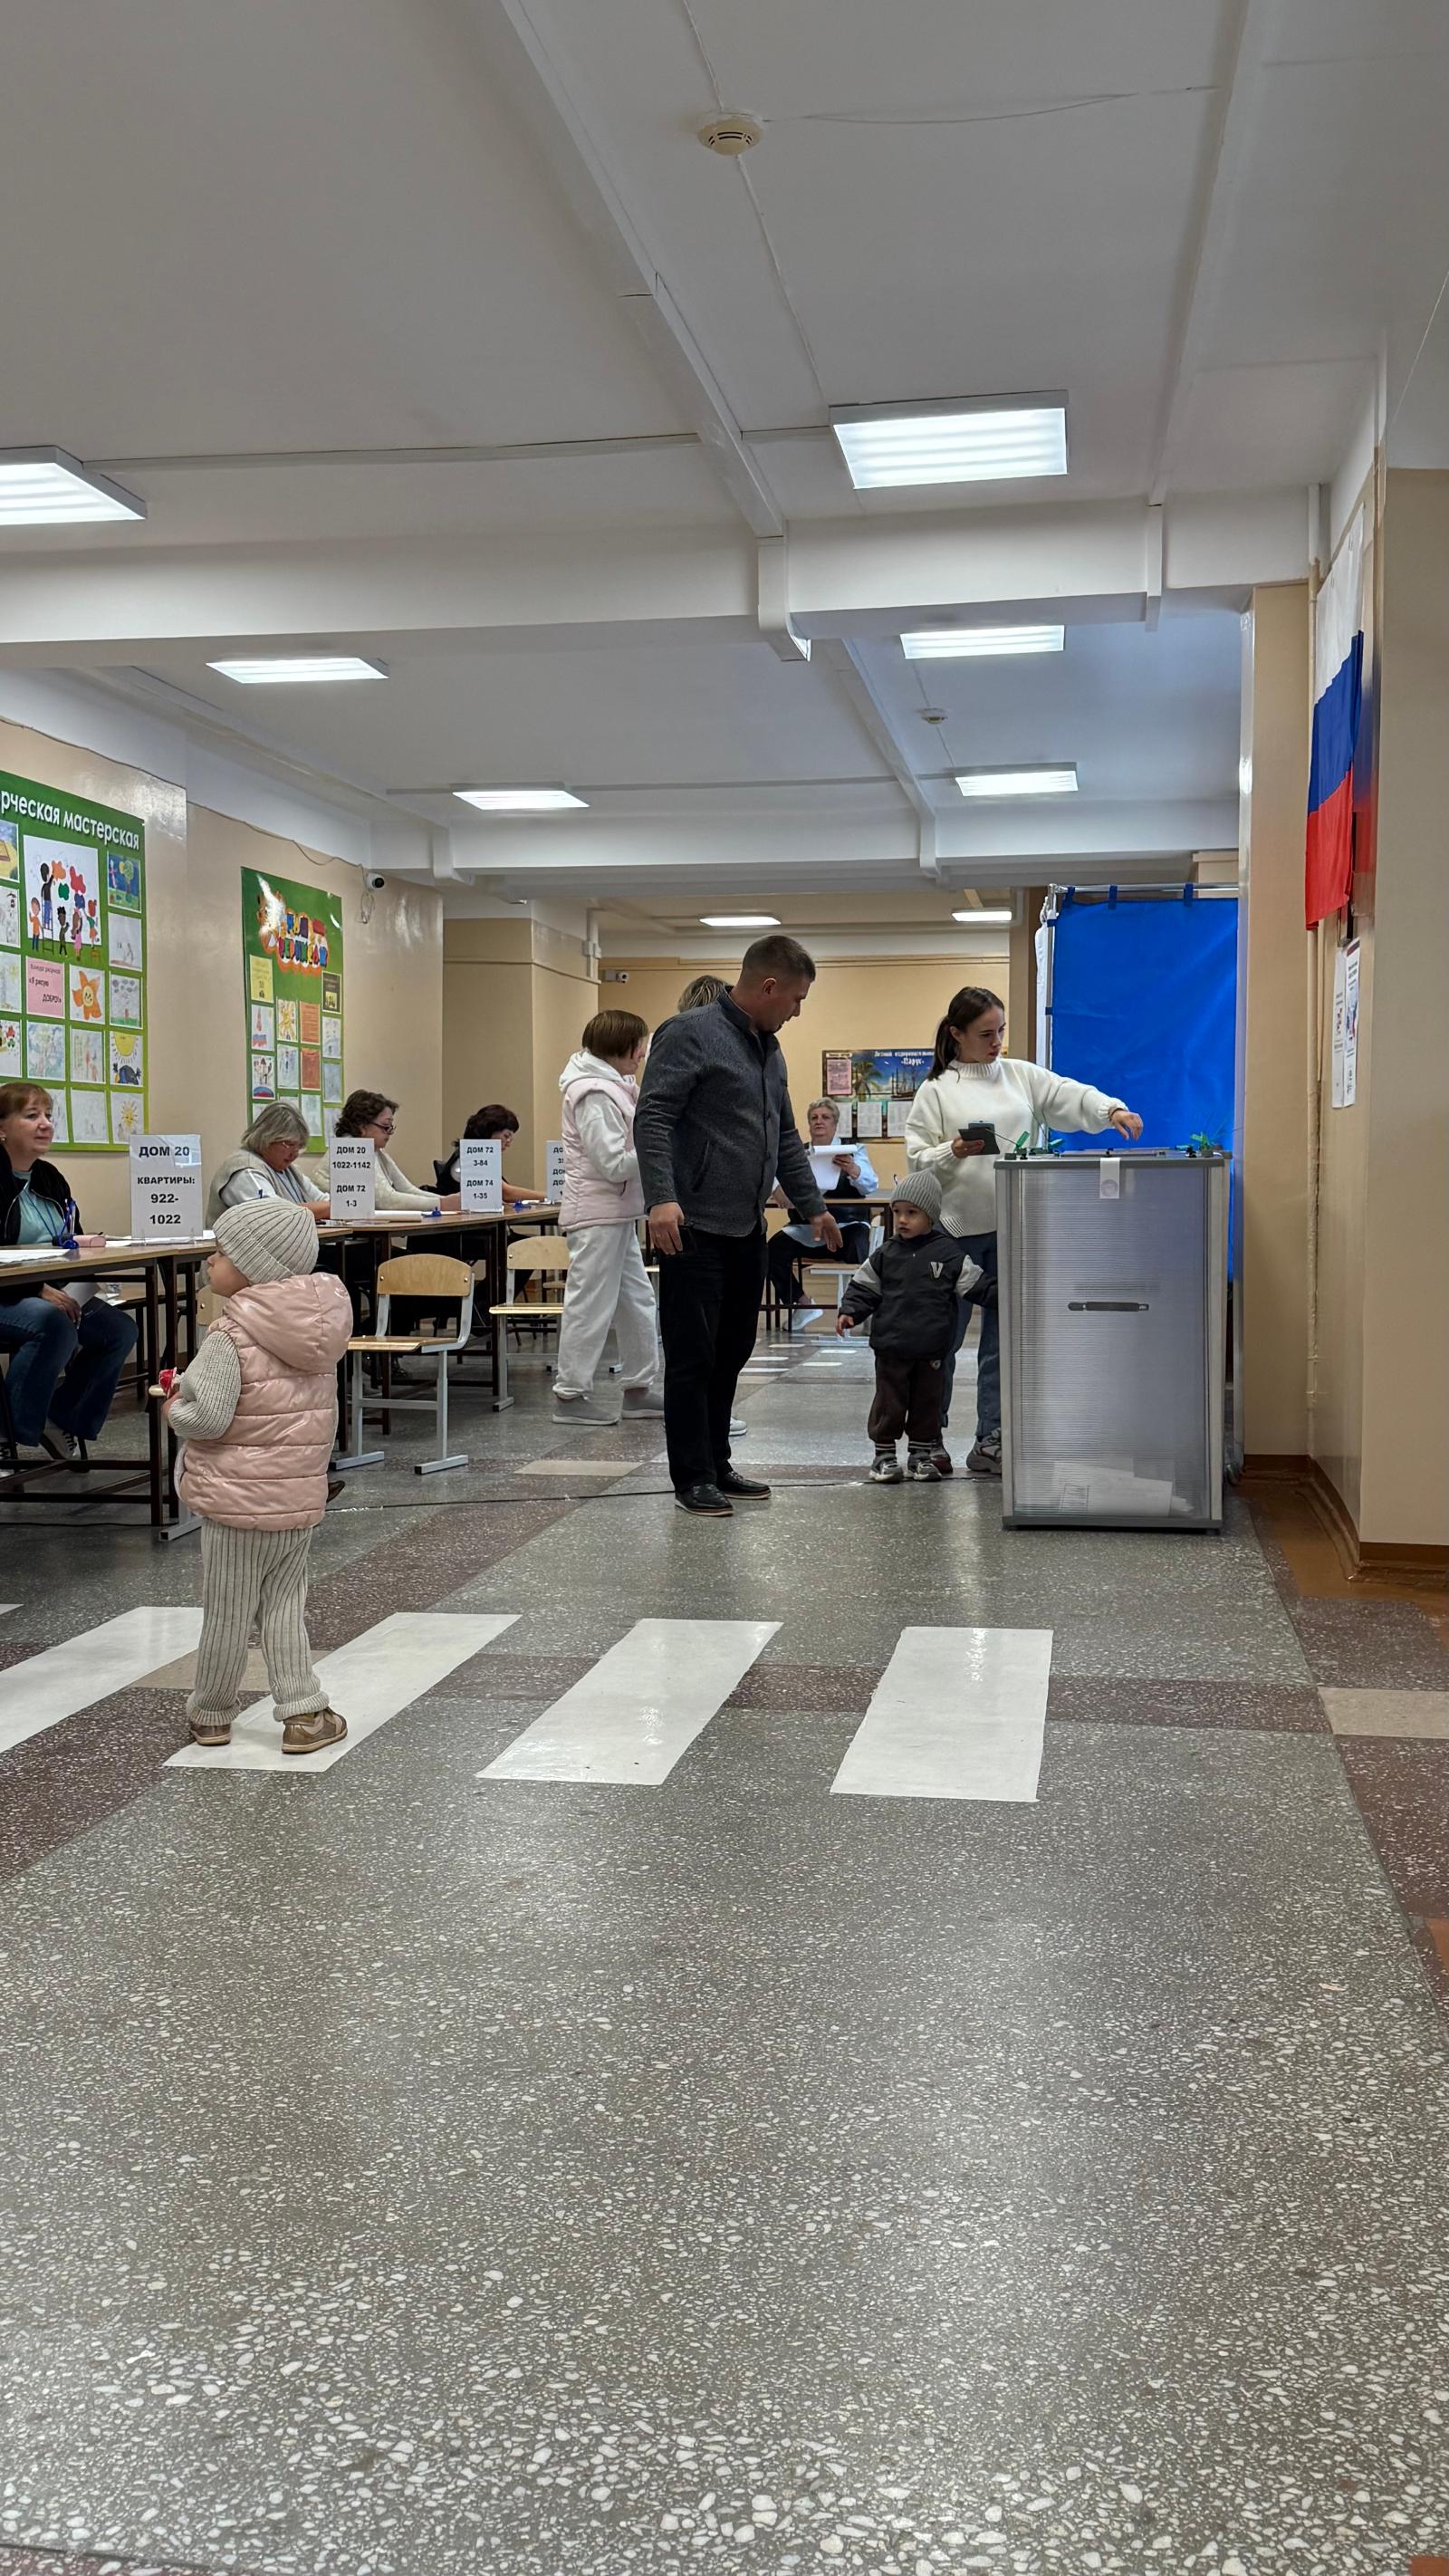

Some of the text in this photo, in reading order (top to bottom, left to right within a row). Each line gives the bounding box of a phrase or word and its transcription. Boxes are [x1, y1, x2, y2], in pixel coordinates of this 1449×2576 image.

[63, 811, 139, 850] мастерская
[139, 1146, 190, 1158] ДОМ 20
[336, 1146, 366, 1154] ДОМ 20
[137, 1177, 196, 1185] КВАРТИРЫ:
[336, 1185, 354, 1193] ДОМ
[150, 1194, 178, 1203] 922-
[149, 1215, 181, 1225] 1022
